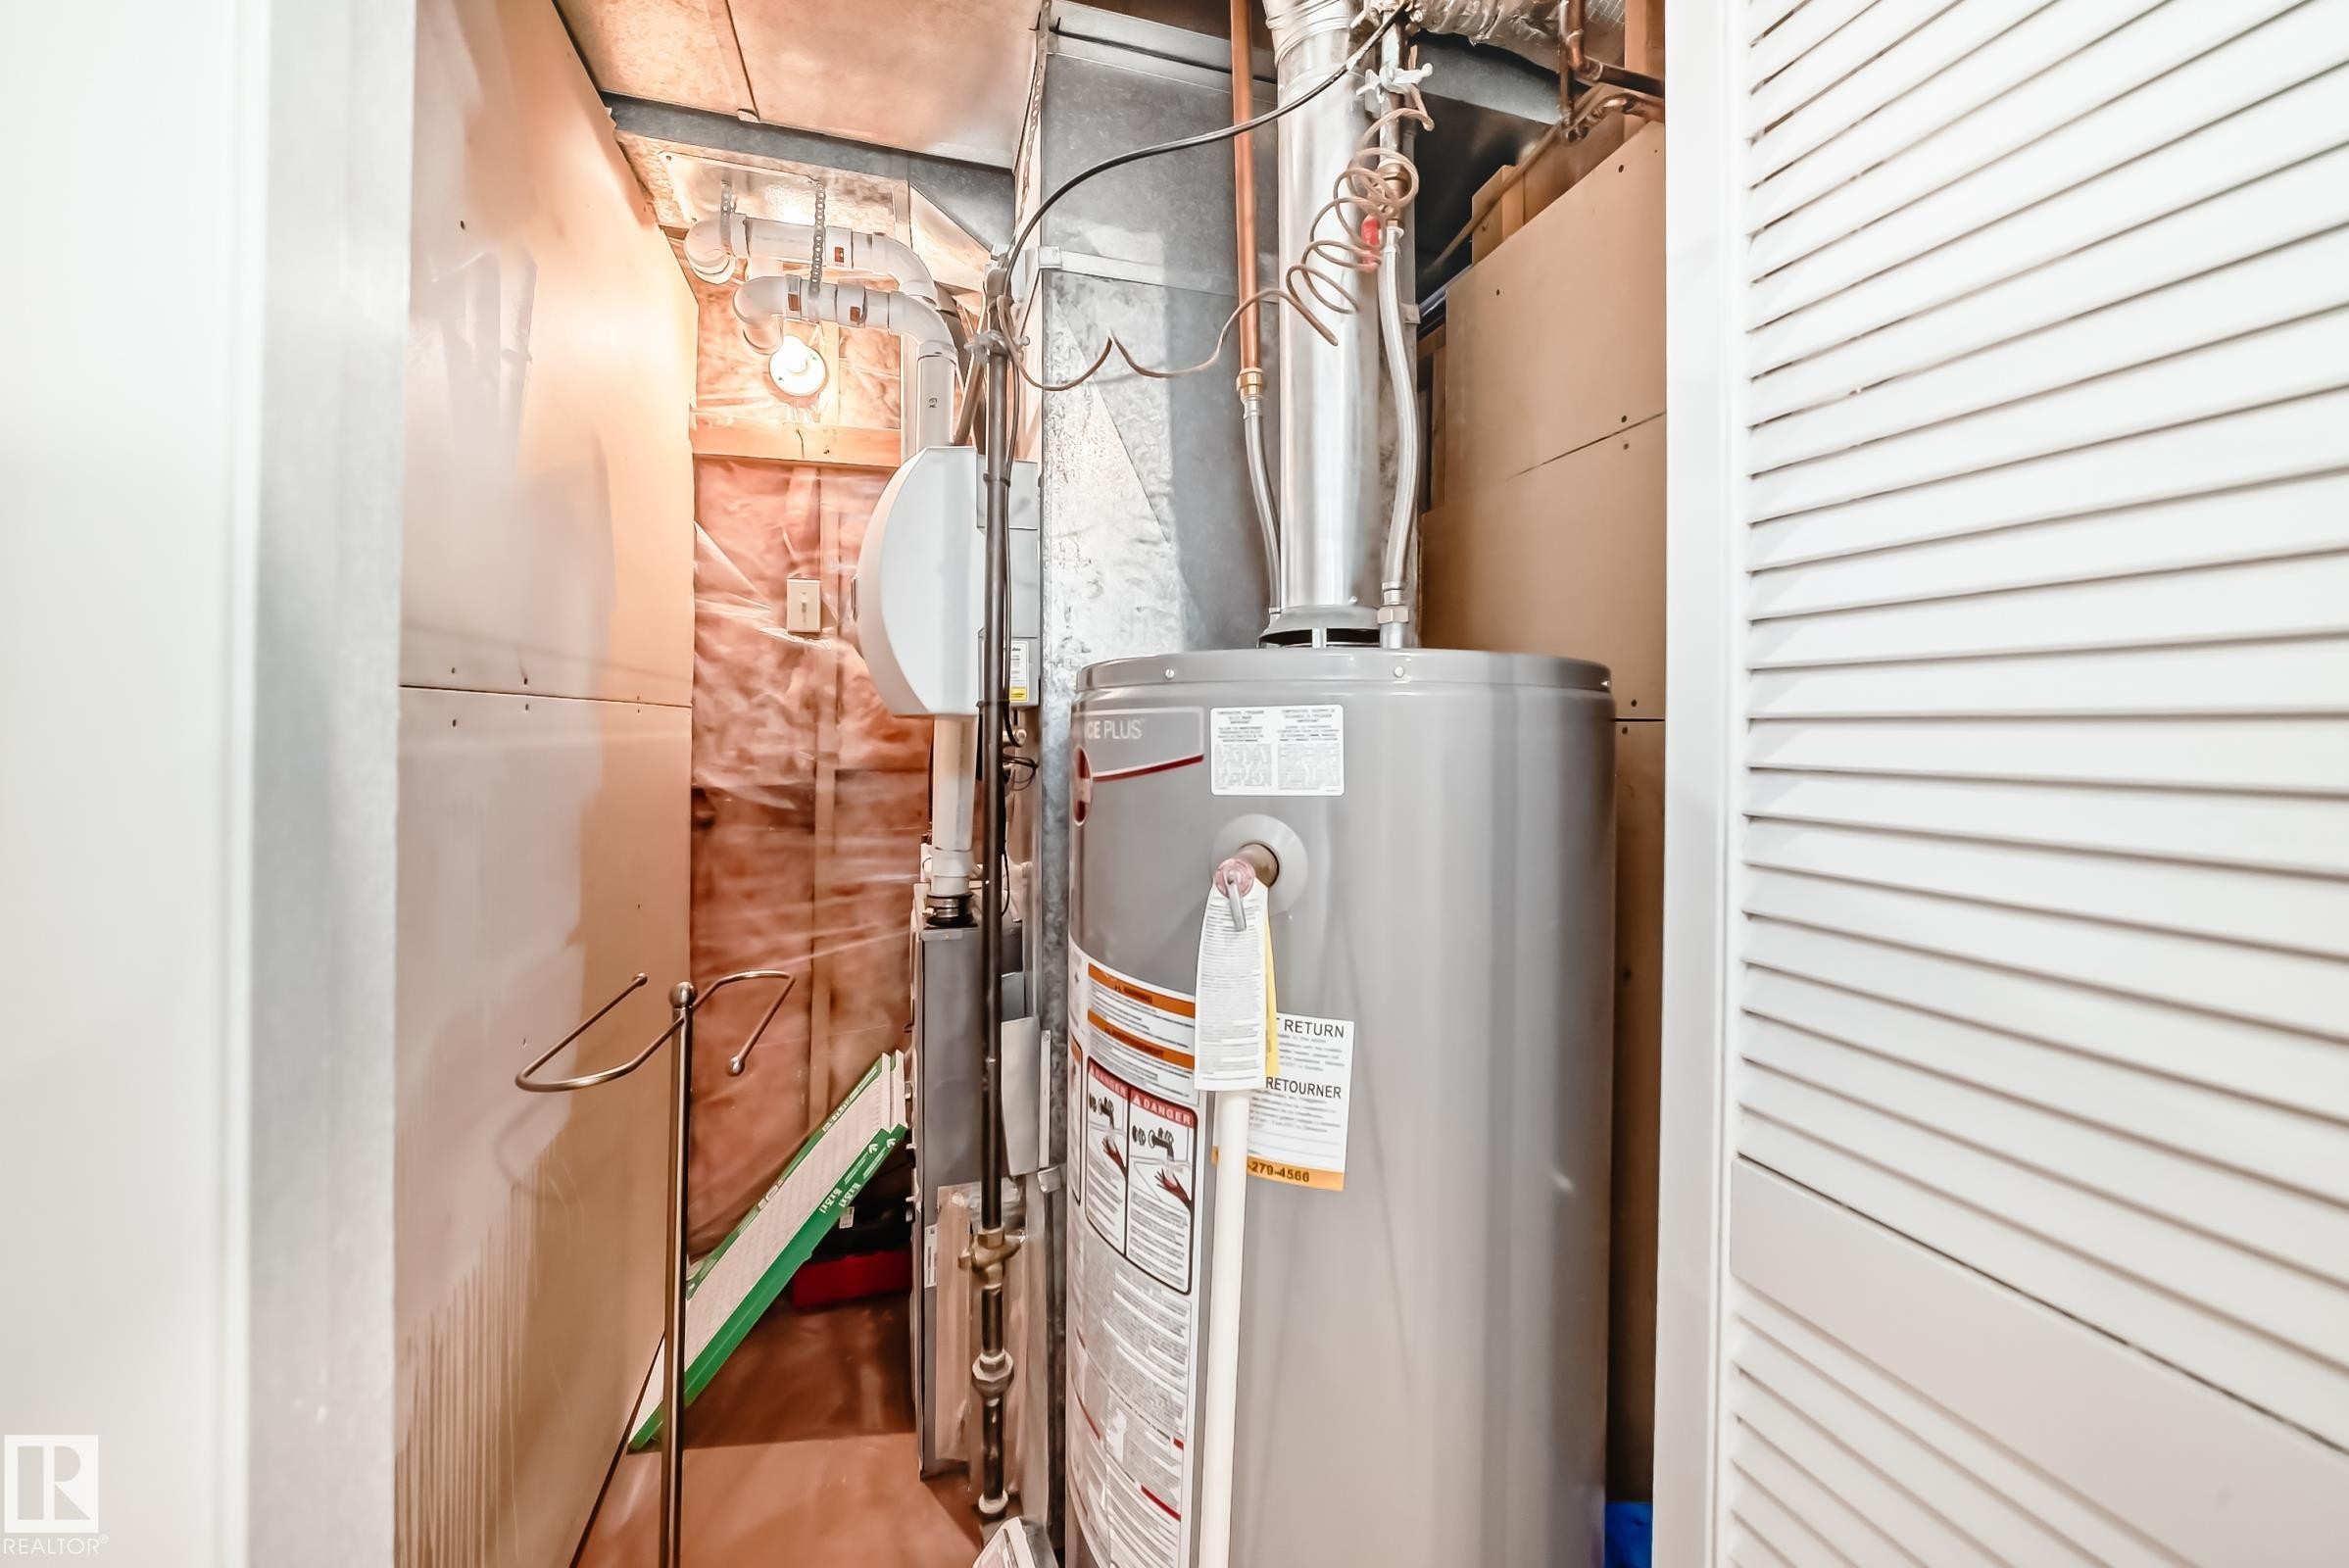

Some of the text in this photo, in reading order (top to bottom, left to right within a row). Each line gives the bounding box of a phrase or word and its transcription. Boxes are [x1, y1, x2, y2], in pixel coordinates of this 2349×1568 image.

[1284, 1018, 1345, 1039] RETURN
[1265, 1076, 1342, 1100] RETOURNER
[1143, 1099, 1192, 1126] DANGER
